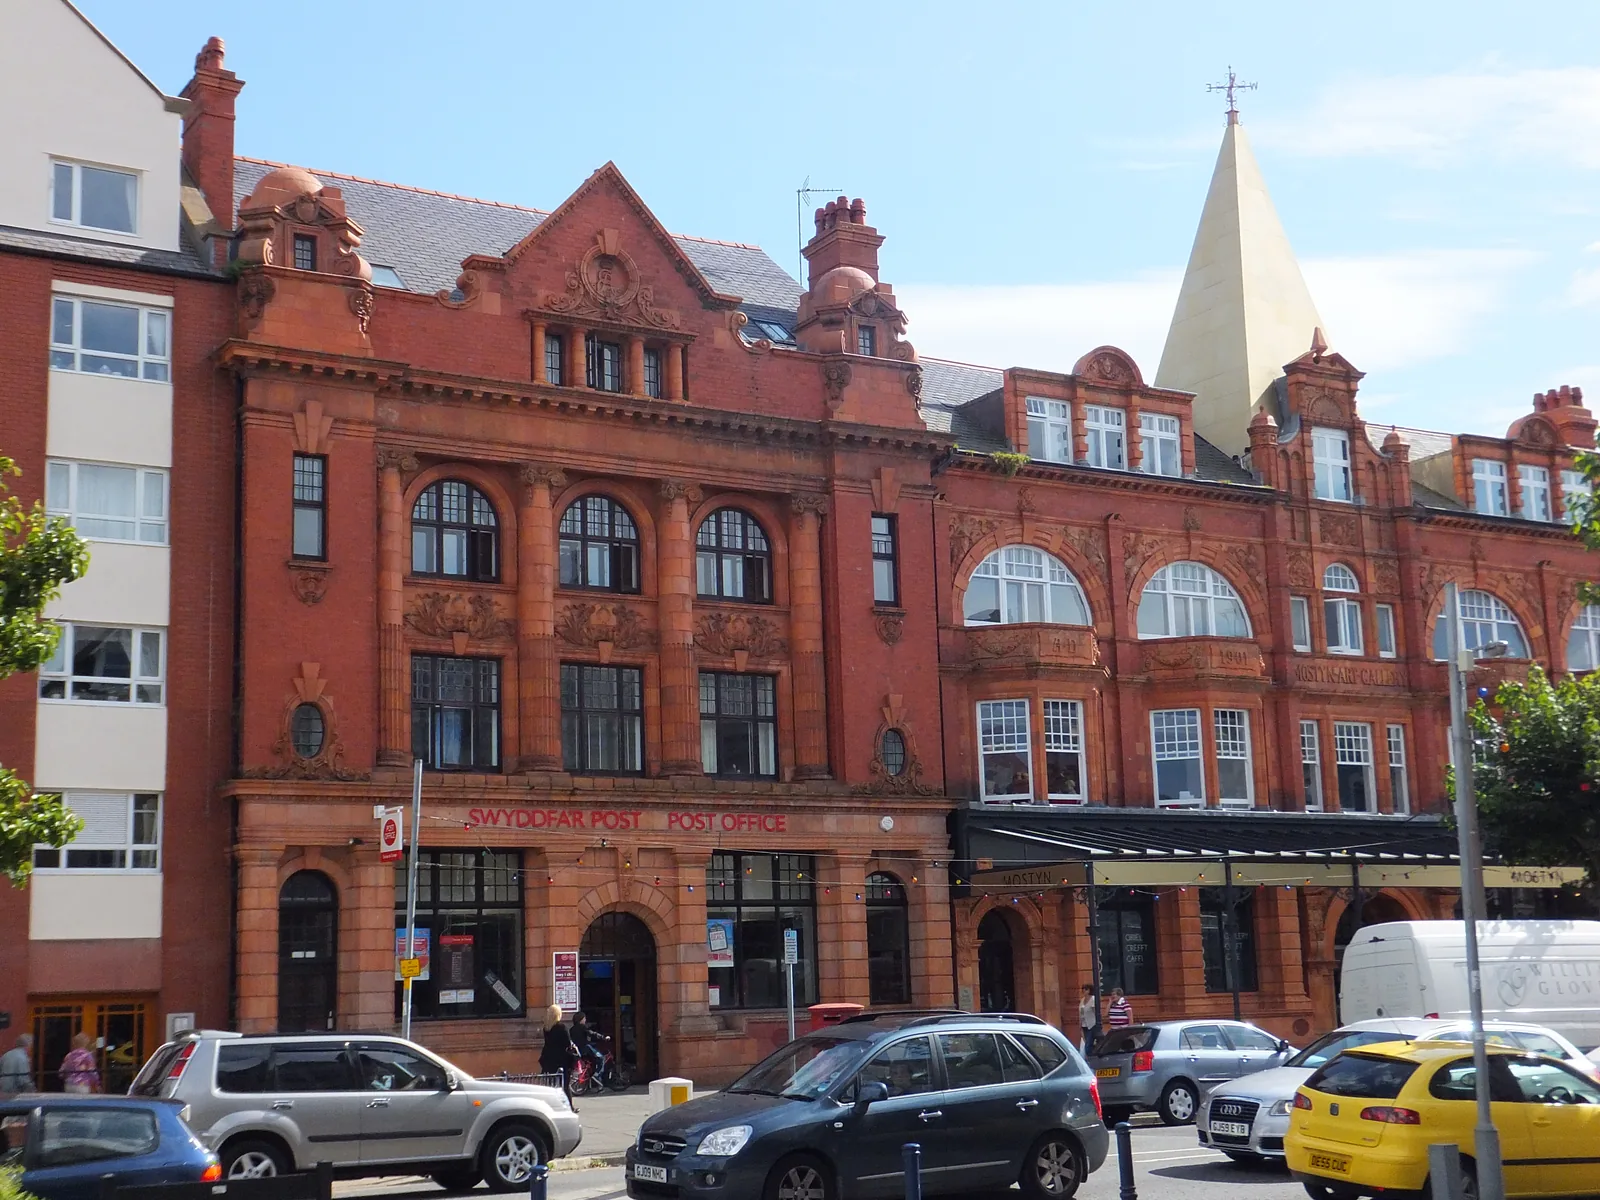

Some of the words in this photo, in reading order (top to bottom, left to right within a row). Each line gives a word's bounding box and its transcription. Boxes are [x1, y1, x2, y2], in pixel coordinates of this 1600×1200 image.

[1219, 650, 1248, 666] 1901
[591, 810, 642, 829] POST
[667, 811, 716, 831] POST
[721, 813, 786, 832] OFFICE
[1003, 872, 1052, 889] MOSTYN
[1527, 963, 1600, 977] WILLI
[1537, 980, 1600, 996] GLOV
[1212, 1122, 1229, 1133] GJ59
[636, 1165, 651, 1178] GJ09
[1311, 1155, 1330, 1169] DE55
[1331, 1159, 1348, 1172] CUC
